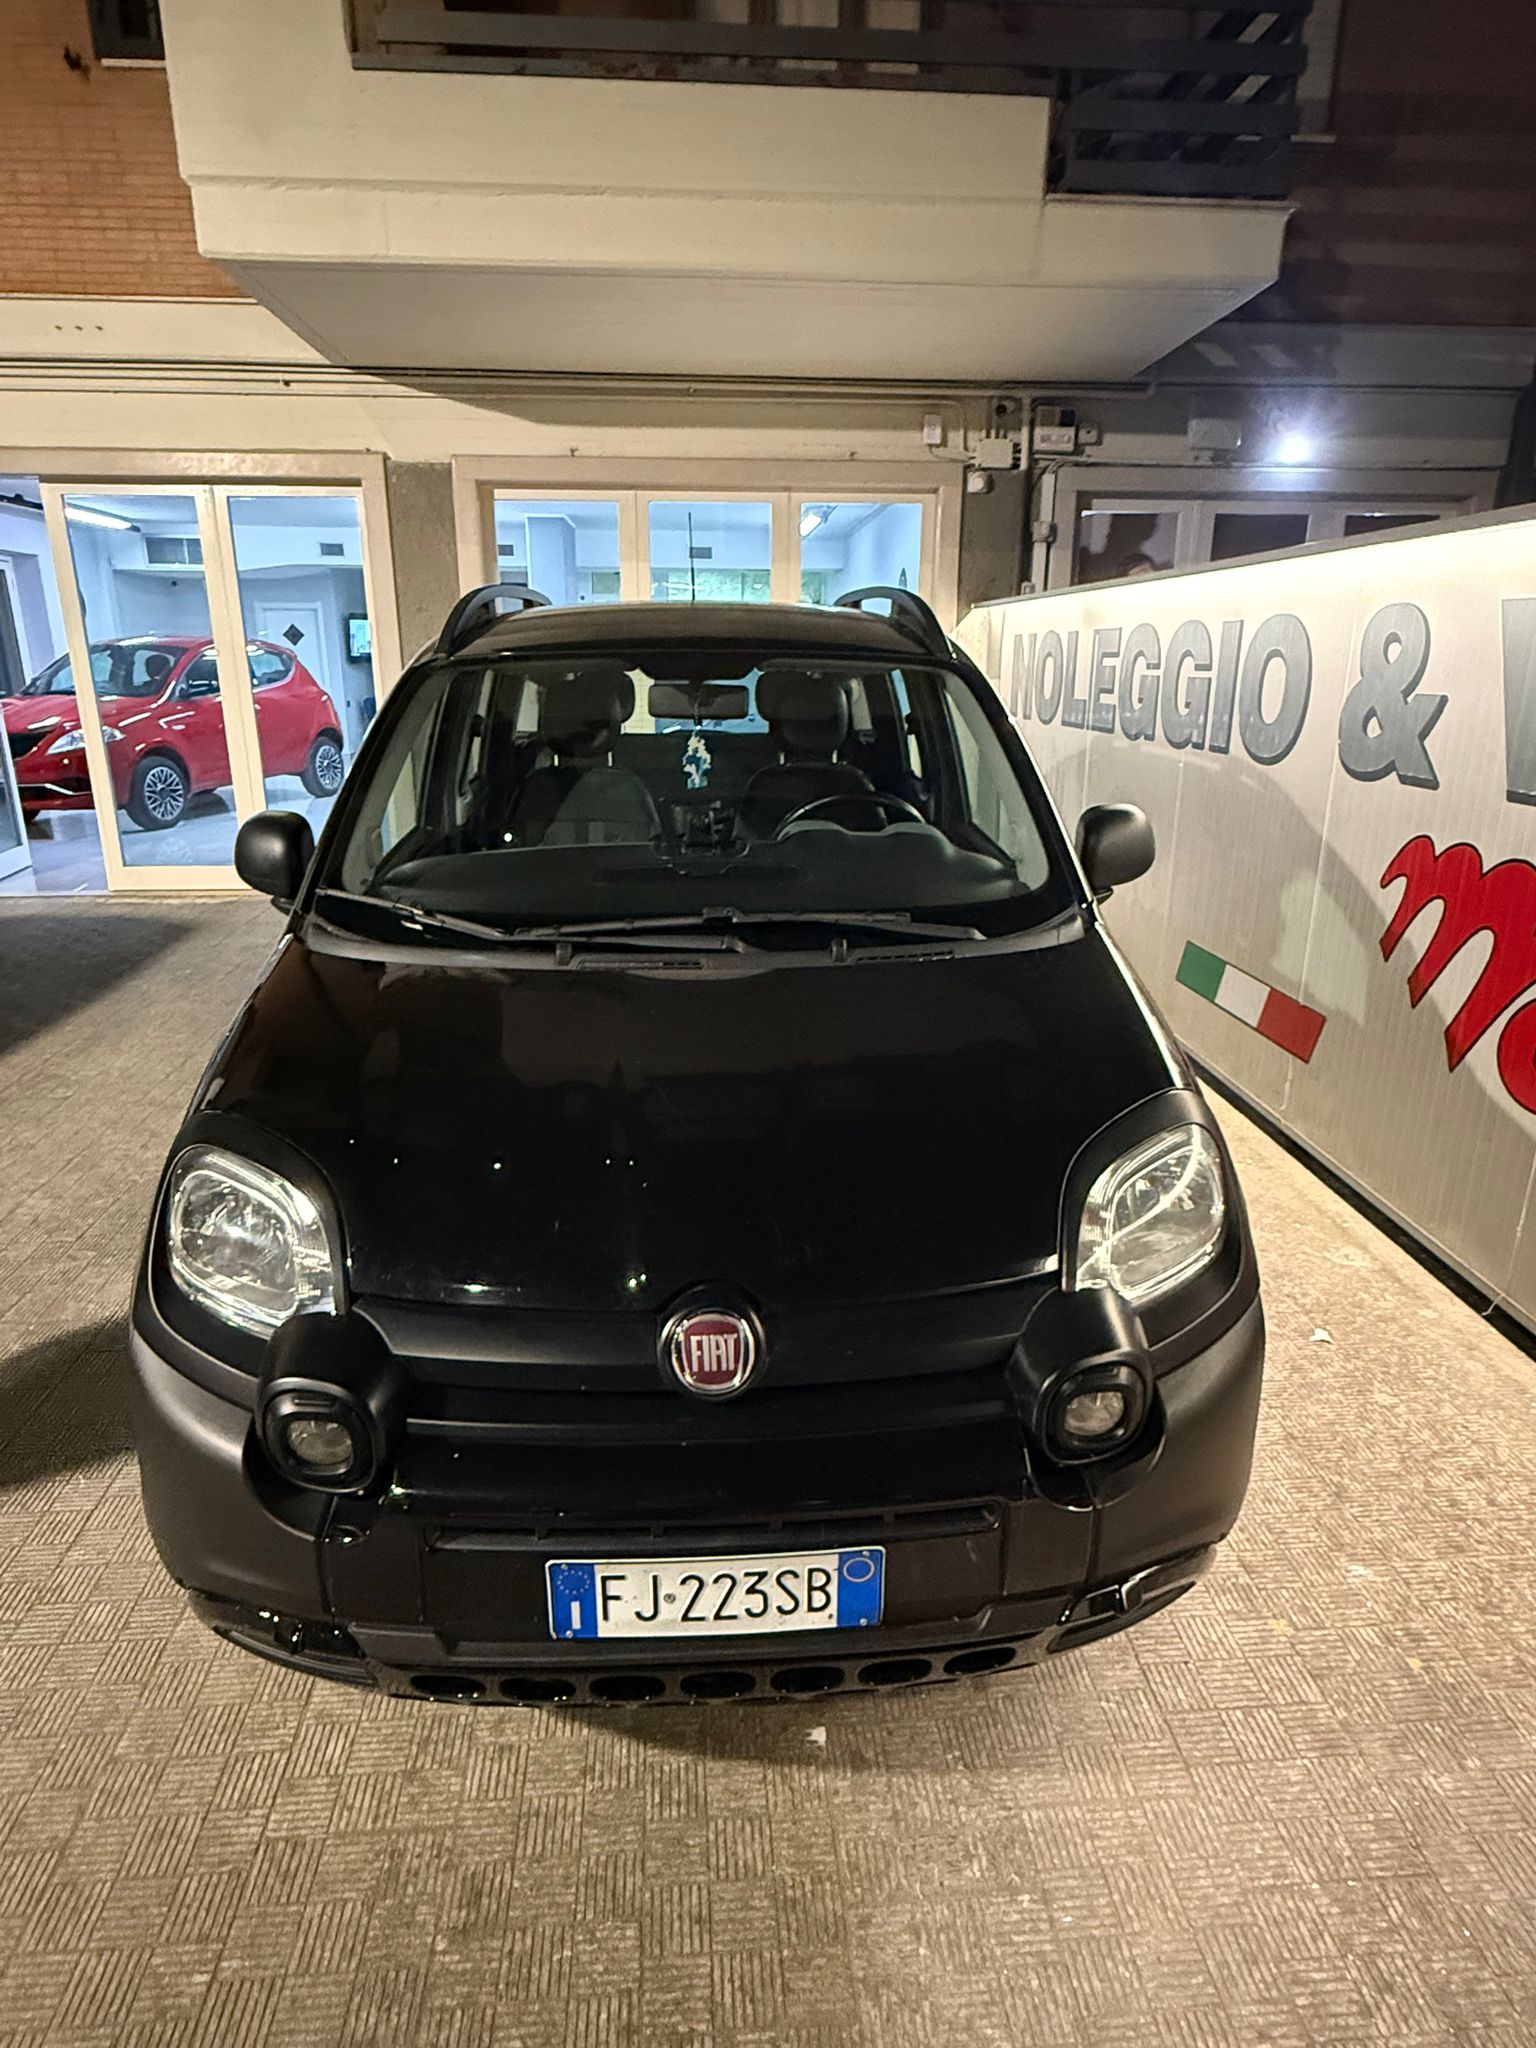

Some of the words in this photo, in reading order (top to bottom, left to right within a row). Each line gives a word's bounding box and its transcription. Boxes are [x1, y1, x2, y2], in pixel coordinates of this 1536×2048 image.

[1012, 612, 1312, 766] NOLEGGIO
[1339, 602, 1448, 791] &
[690, 1333, 738, 1372] FIAT
